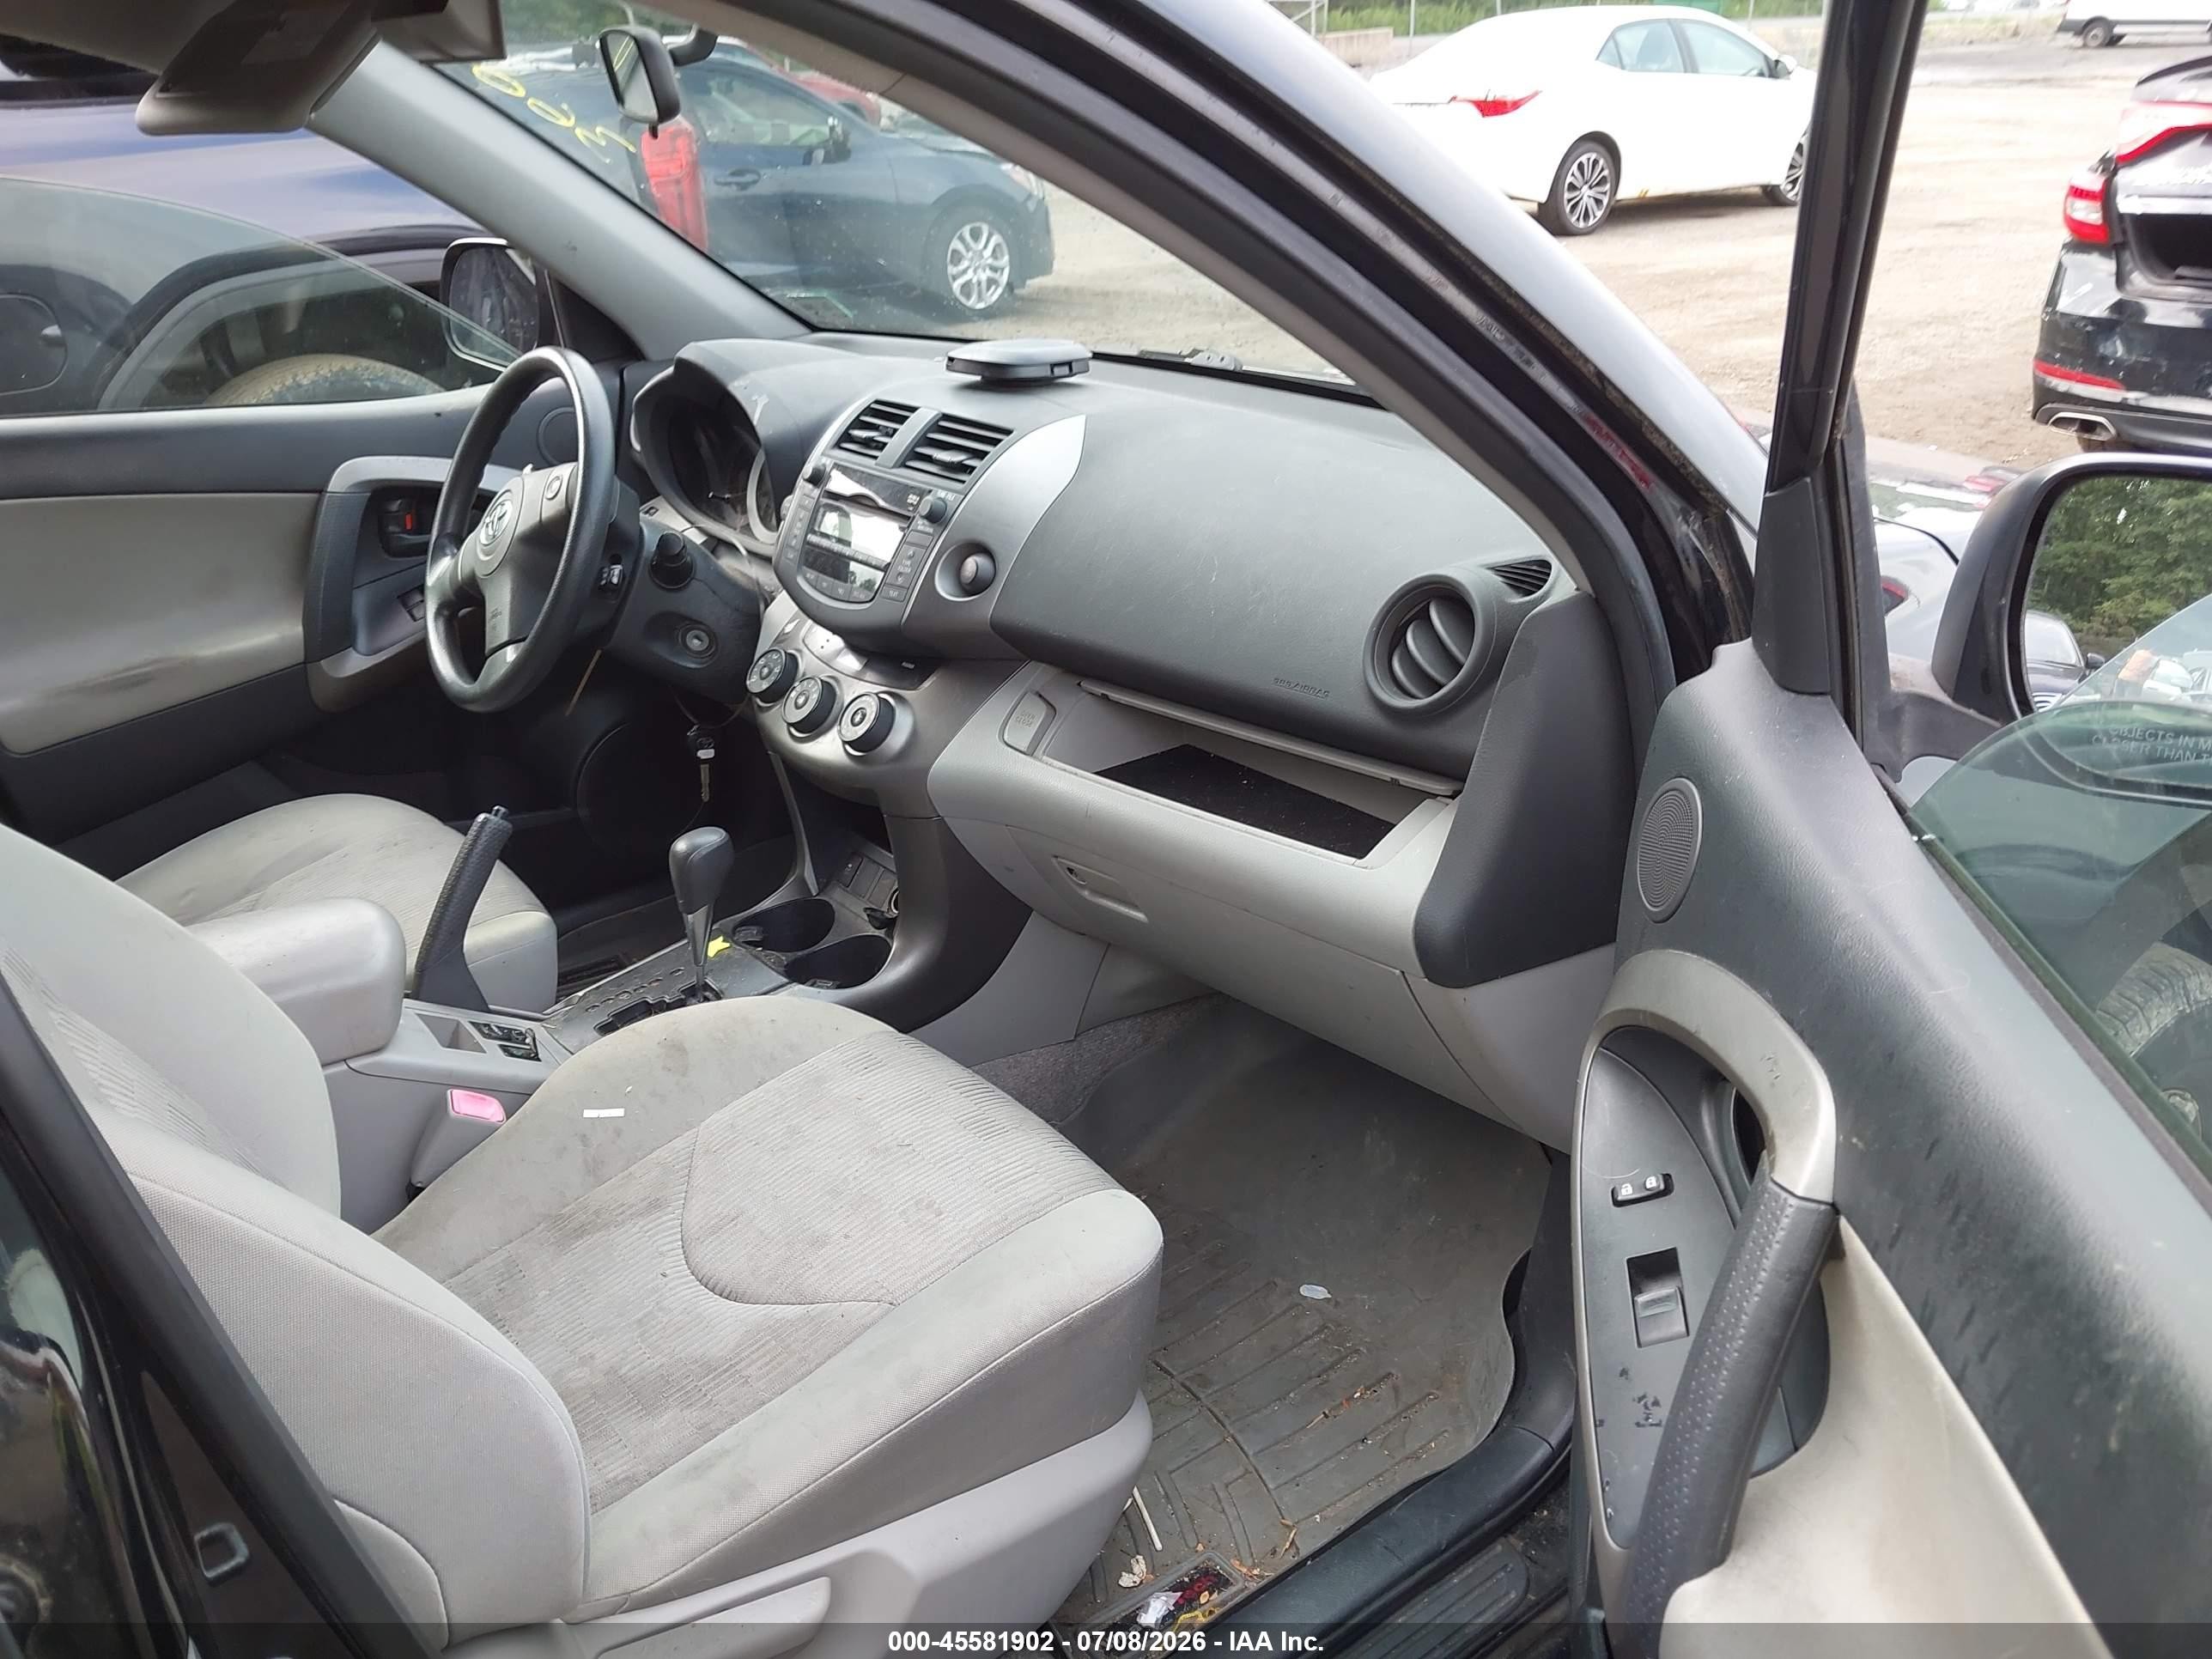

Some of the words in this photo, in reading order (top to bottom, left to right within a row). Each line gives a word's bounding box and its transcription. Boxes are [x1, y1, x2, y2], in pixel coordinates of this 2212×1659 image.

[2108, 727, 2174, 745] OBJECTS
[2179, 734, 2195, 748] IN
[2156, 745, 2197, 763] THAN
